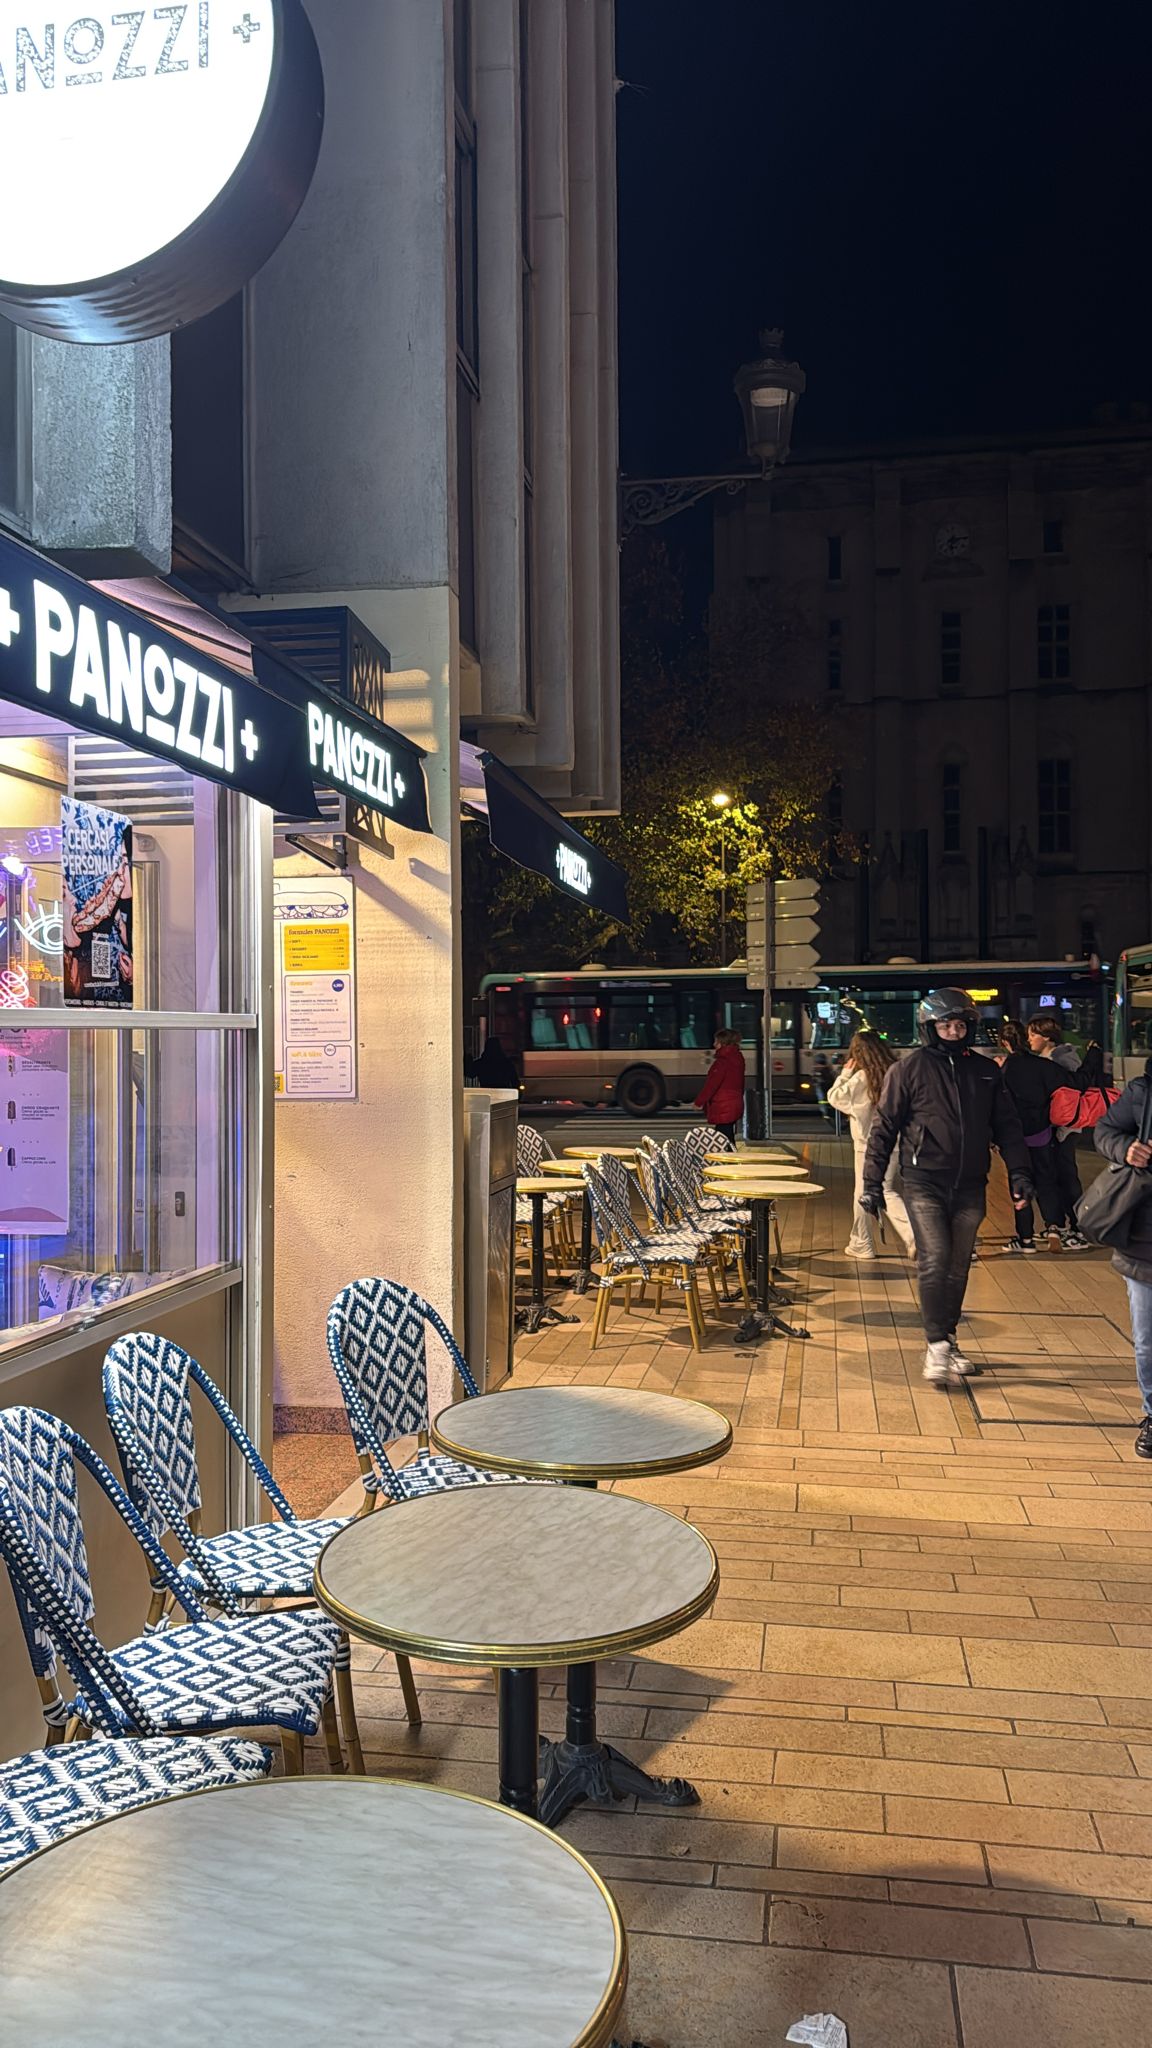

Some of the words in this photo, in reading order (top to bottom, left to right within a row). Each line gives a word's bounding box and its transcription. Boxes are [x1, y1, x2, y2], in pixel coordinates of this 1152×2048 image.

[0, 2, 208, 94] NOZZI
[33, 579, 235, 774] PANOZZI
[307, 701, 394, 807] PANOZZI
[61, 854, 120, 876] PERSONALE
[68, 829, 110, 851] CERCASI
